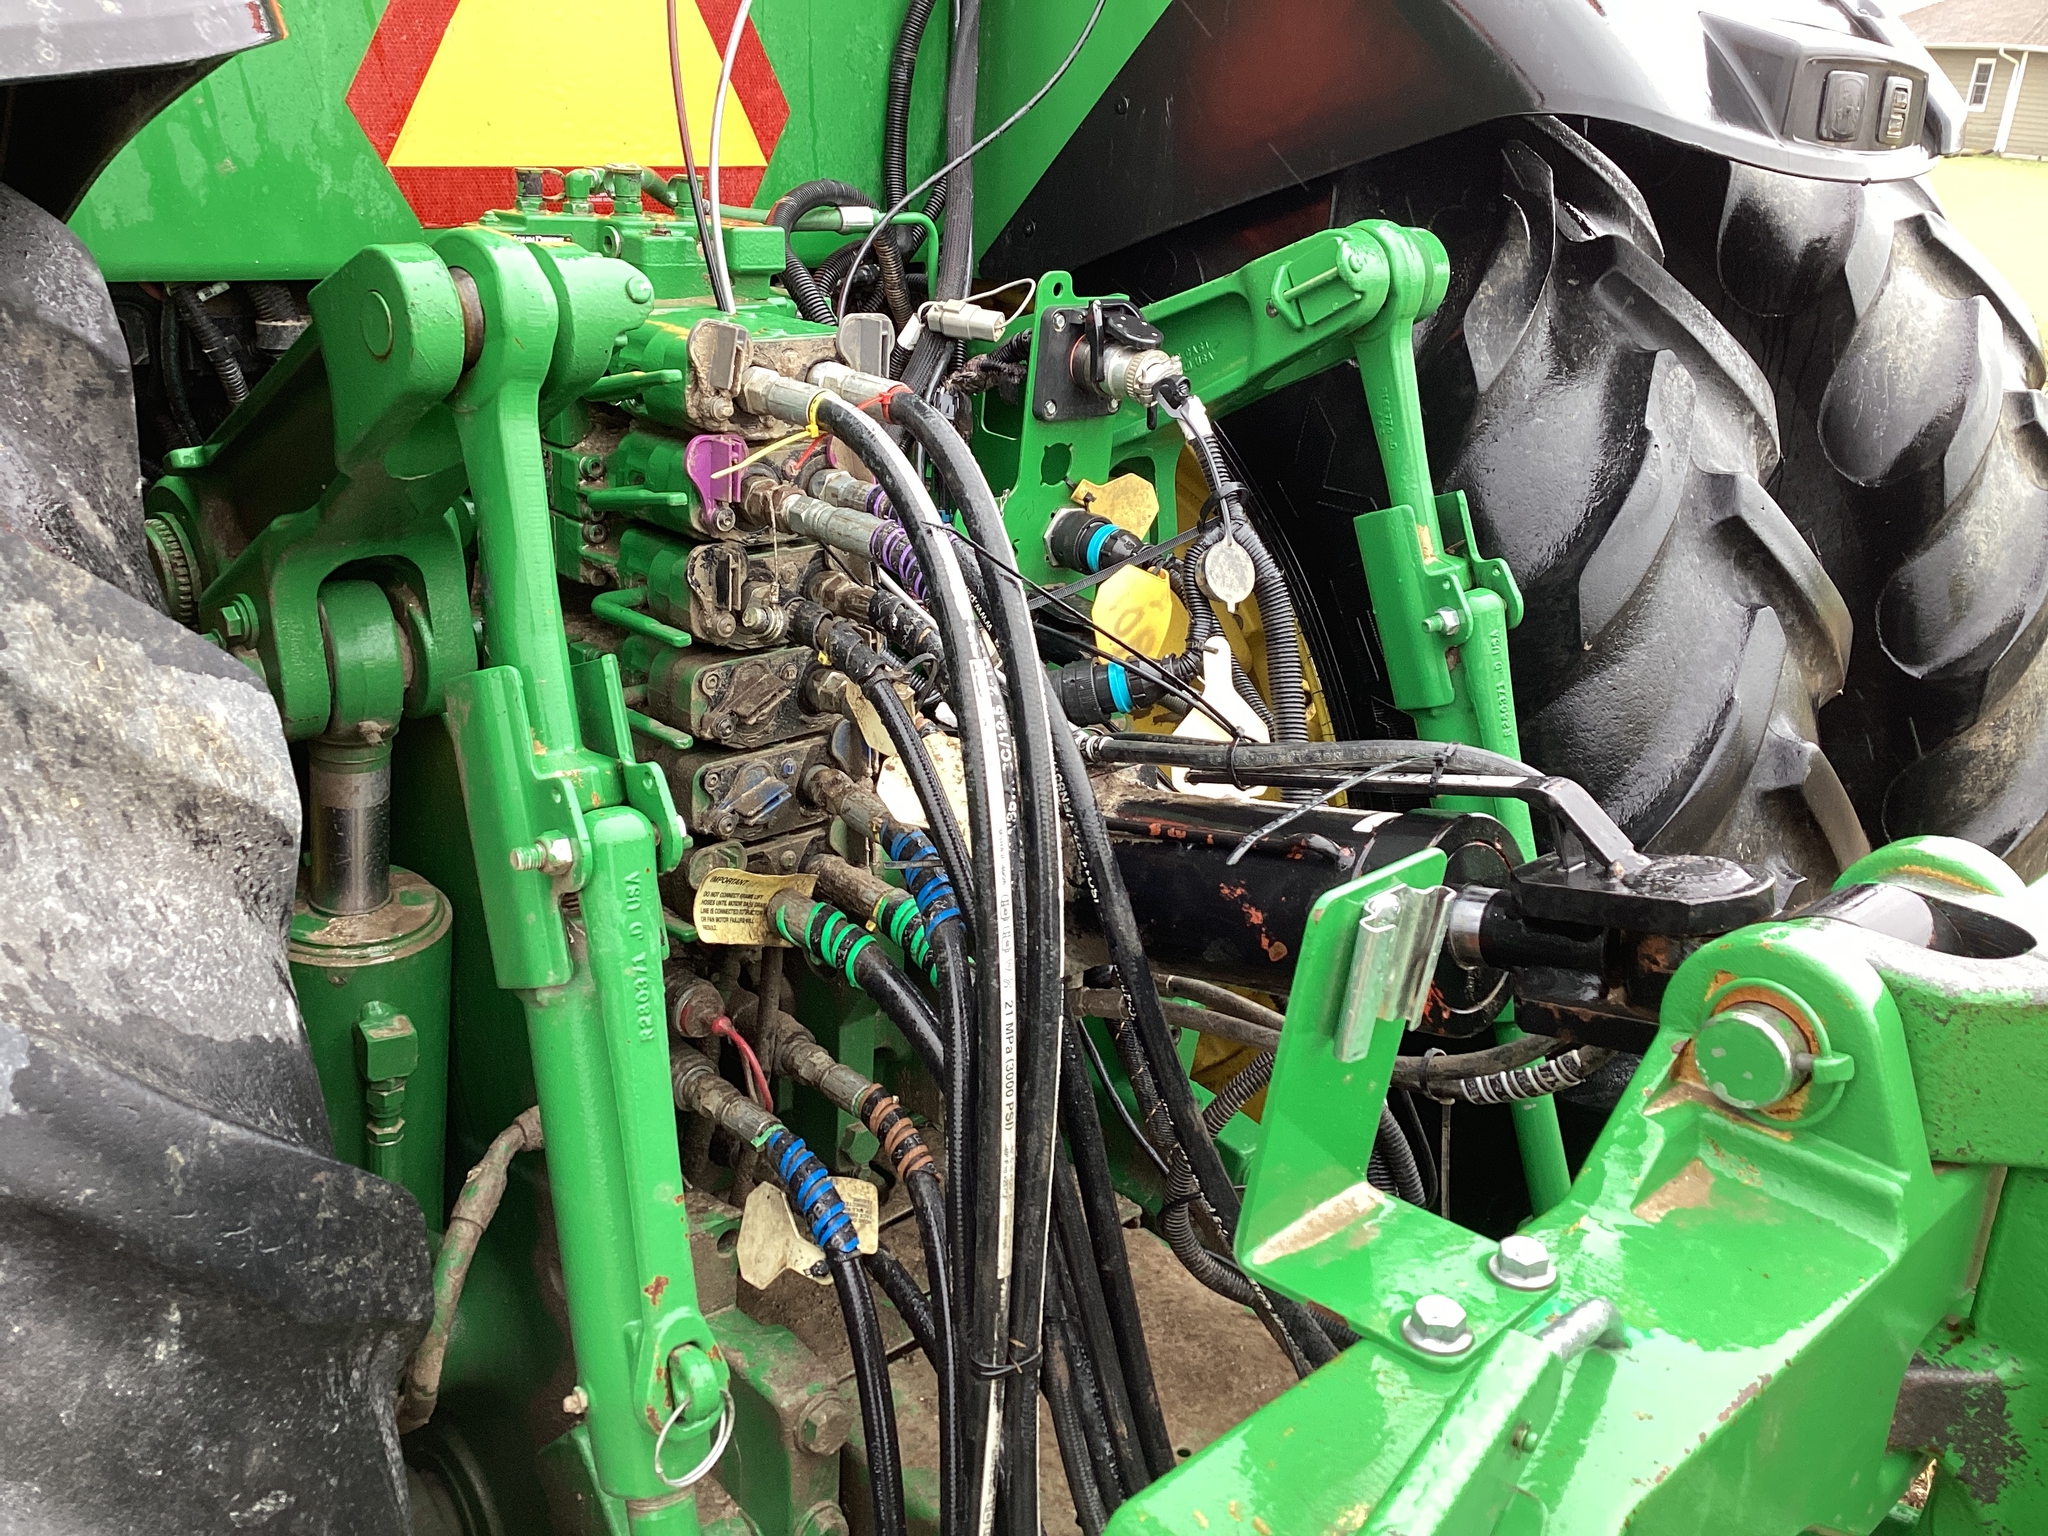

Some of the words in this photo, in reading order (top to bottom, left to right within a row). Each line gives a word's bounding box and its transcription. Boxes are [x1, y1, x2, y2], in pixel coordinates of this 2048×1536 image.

[1489, 629, 1501, 656] USA
[625, 871, 641, 912] USA
[710, 876, 749, 885] IMPORTANT
[1003, 1000, 1014, 1016] 21
[1005, 1022, 1014, 1054] MPa
[1005, 1058, 1015, 1098] (3000
[1005, 1101, 1014, 1131] PSI)
